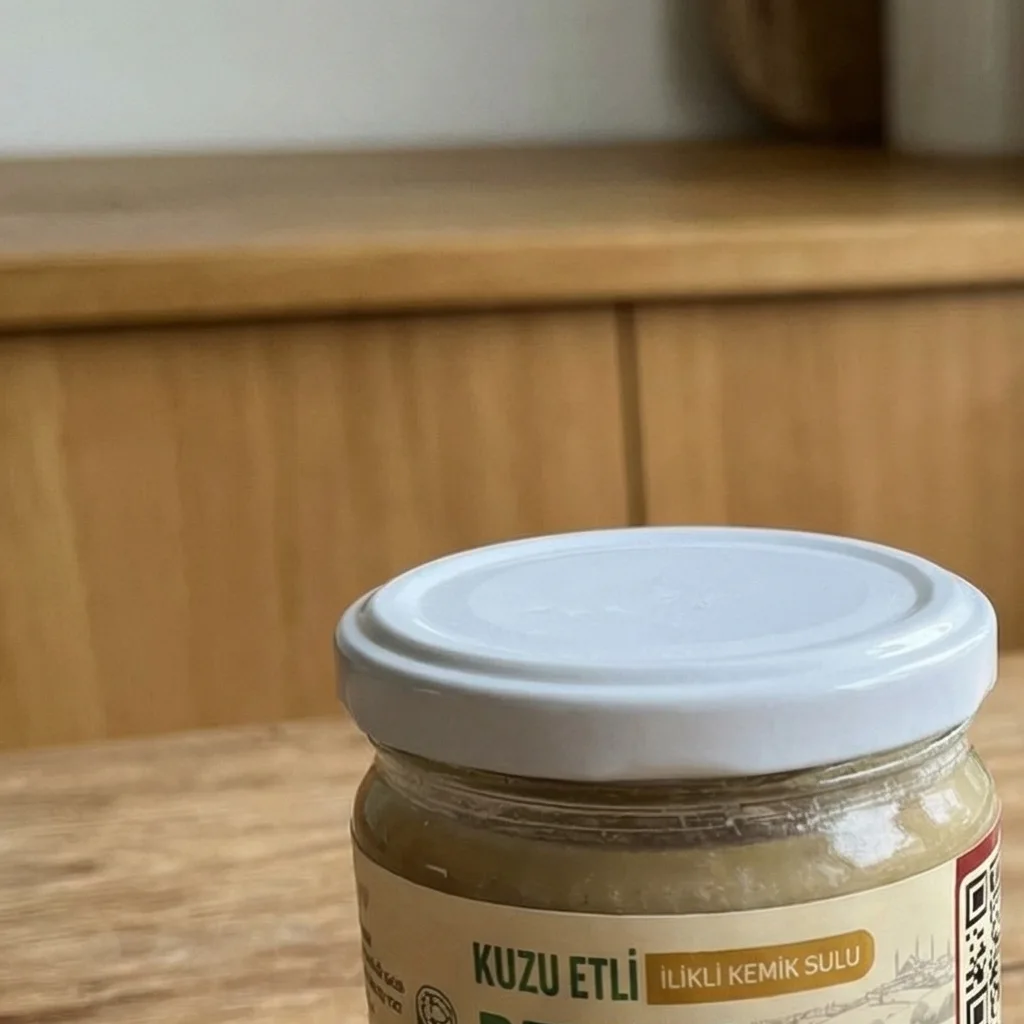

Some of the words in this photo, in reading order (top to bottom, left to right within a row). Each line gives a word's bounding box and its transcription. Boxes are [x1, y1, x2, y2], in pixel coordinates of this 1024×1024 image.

[472, 941, 559, 997] KUZU
[570, 948, 640, 1002] ETLİ
[660, 963, 722, 990] İLİKLİ
[728, 957, 800, 986] KEMİK
[804, 945, 861, 976] SULU
